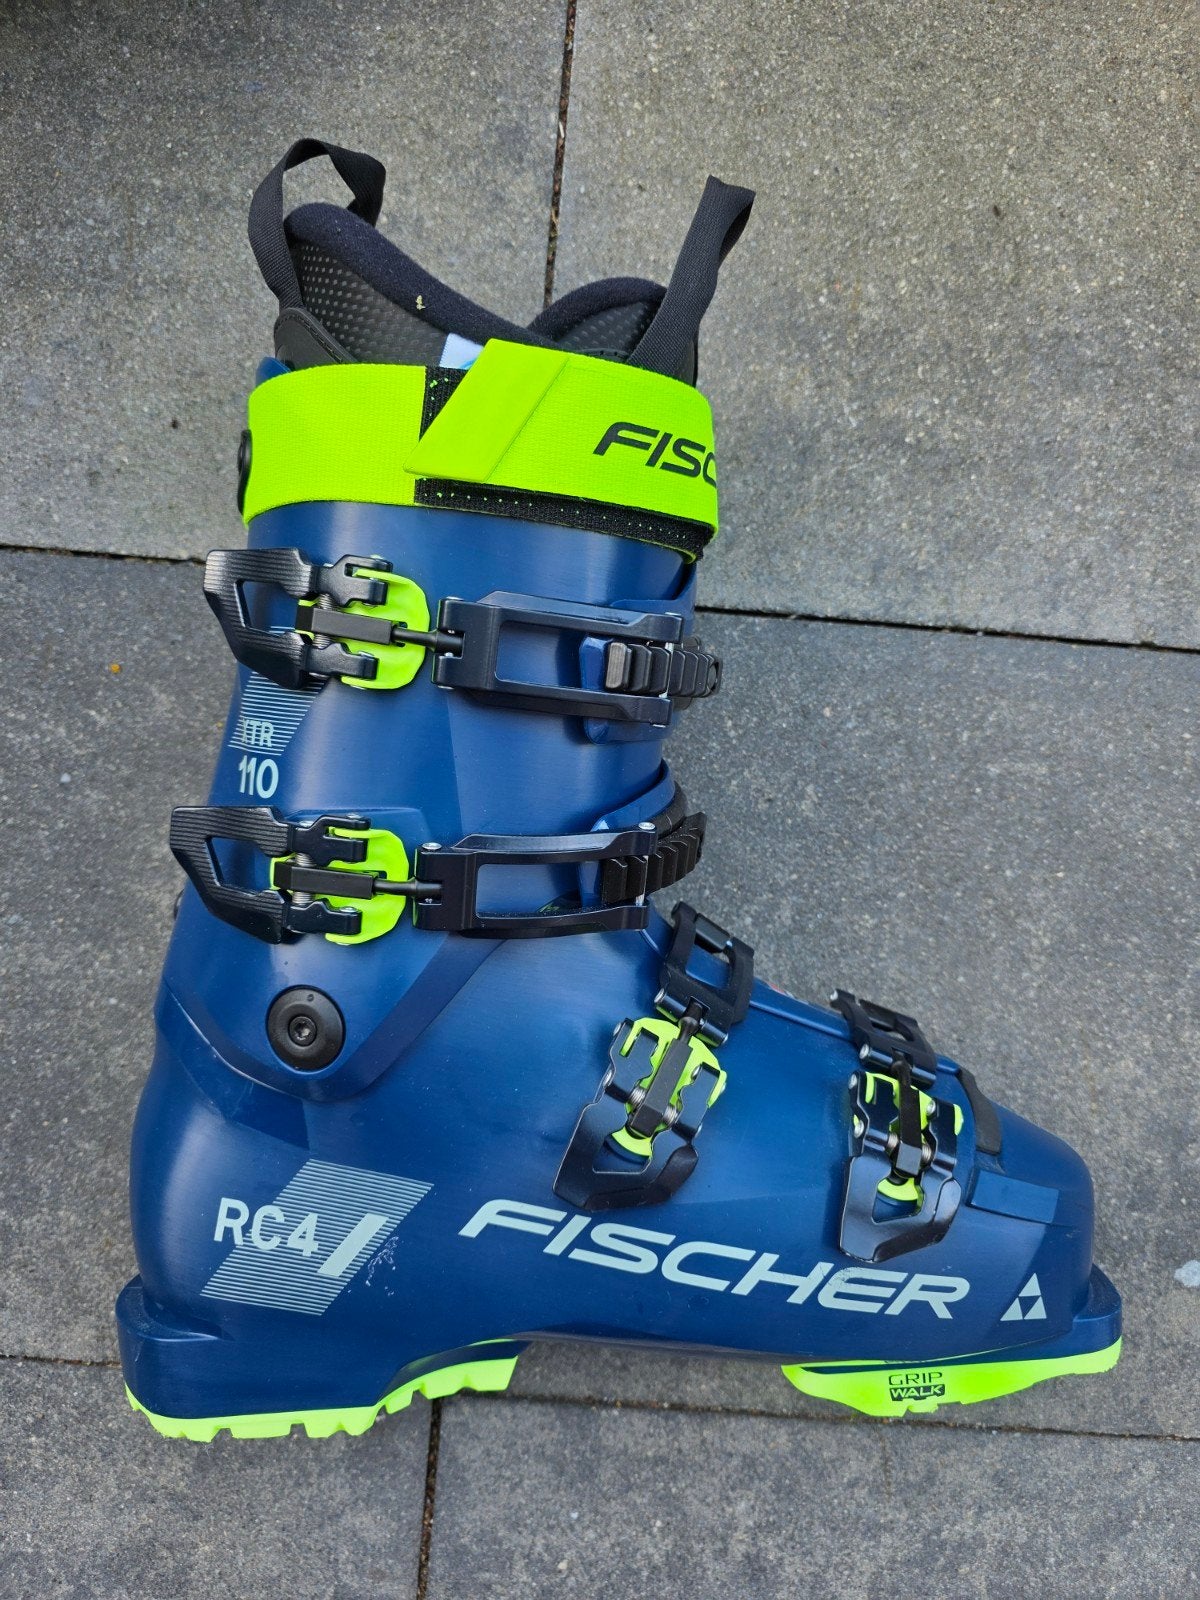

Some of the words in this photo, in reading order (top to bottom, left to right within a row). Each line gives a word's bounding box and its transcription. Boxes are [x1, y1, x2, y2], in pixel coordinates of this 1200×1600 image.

[238, 755, 279, 799] 110
[213, 1197, 320, 1258] RC4
[458, 1199, 971, 1319] FISCHER
[888, 1371, 943, 1386] GRIP
[890, 1384, 943, 1399] WALK
